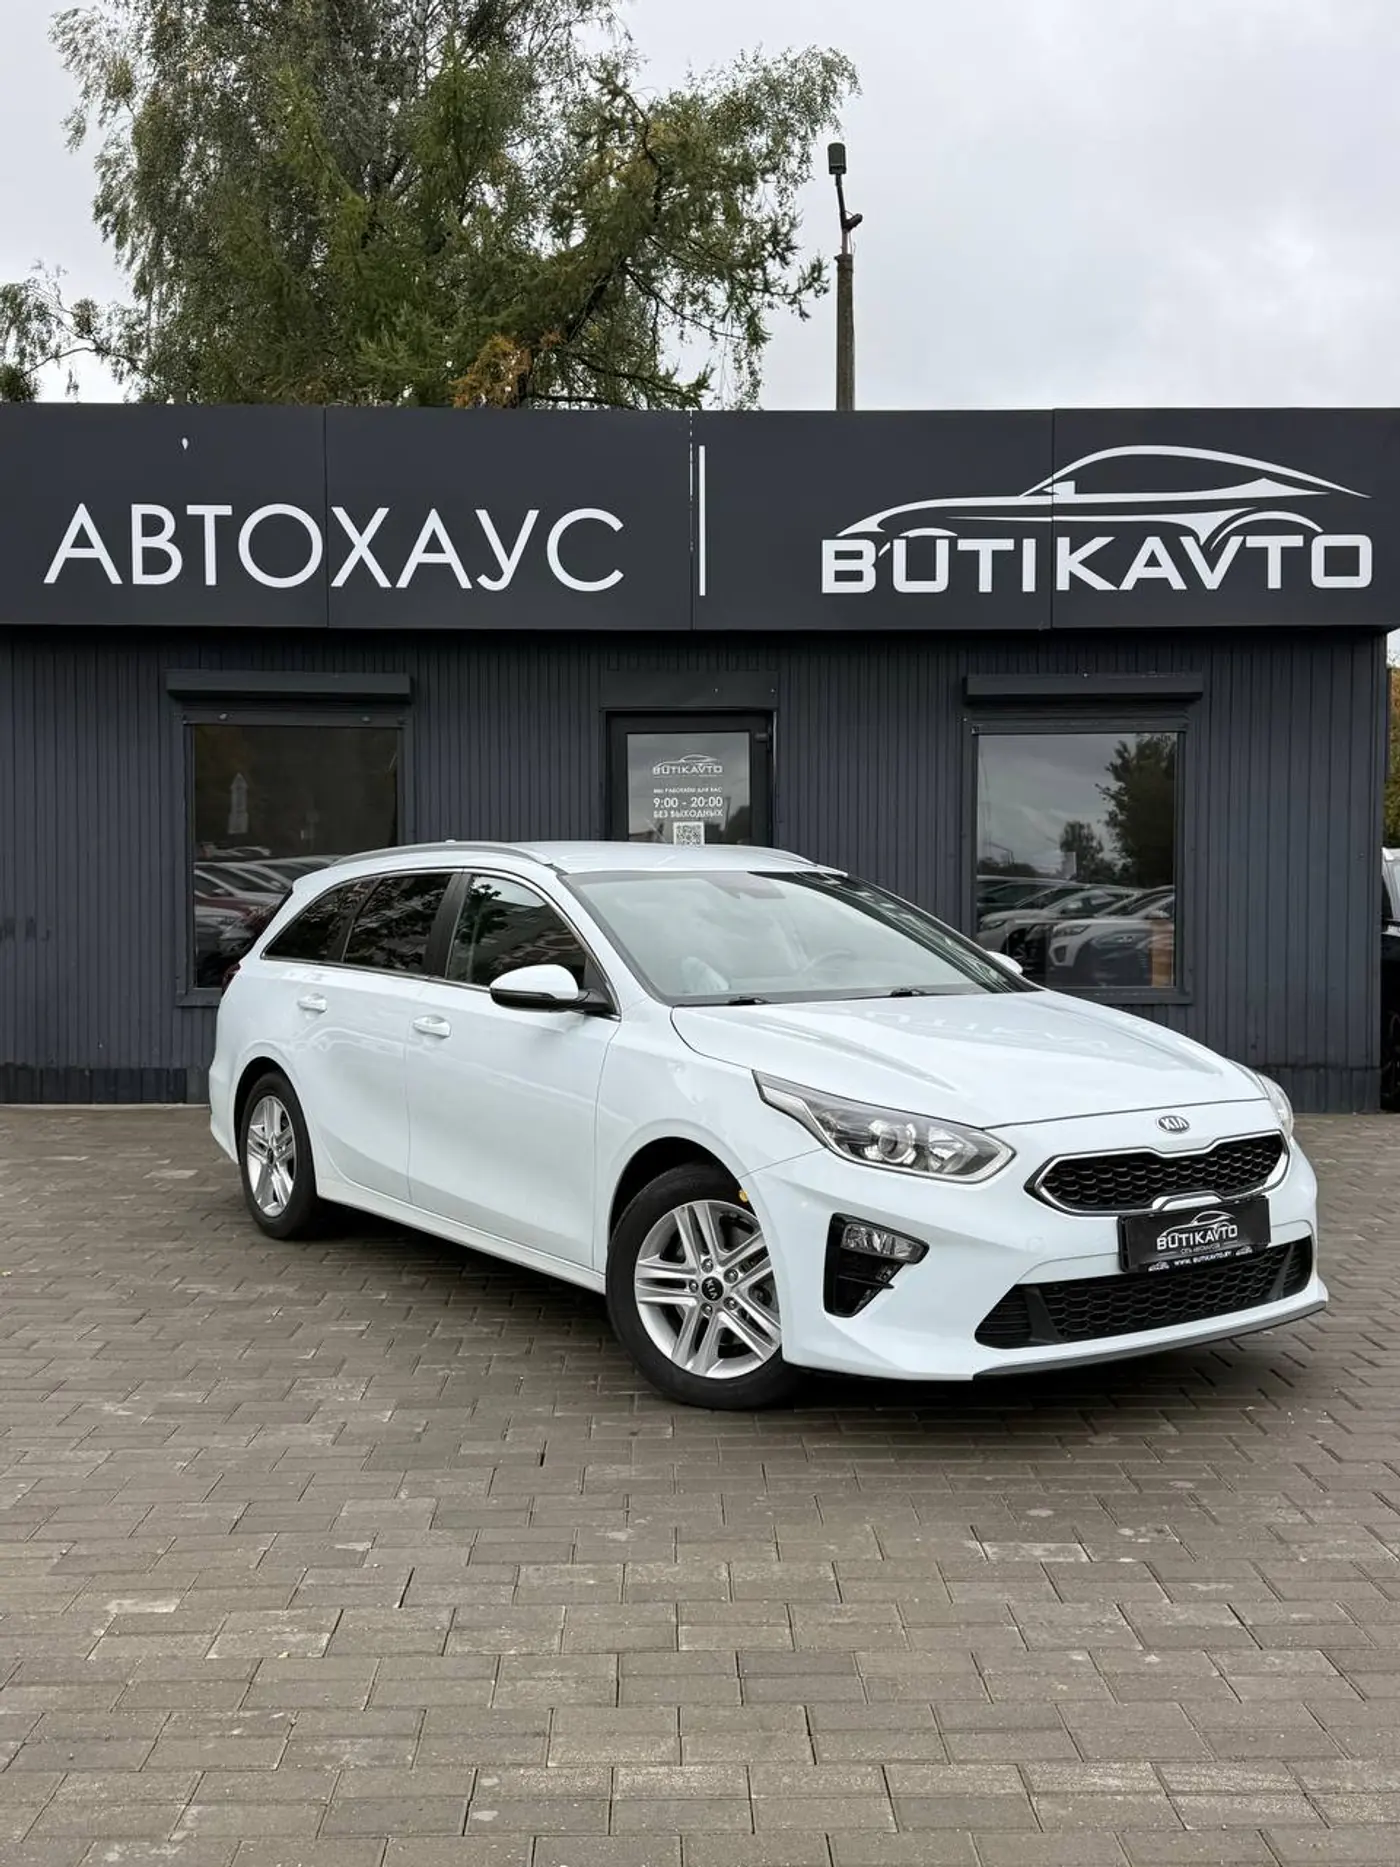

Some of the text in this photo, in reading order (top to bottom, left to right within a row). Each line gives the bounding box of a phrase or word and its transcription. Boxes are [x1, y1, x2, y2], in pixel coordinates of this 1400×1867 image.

[43, 502, 625, 592] АВТОХАУС
[821, 534, 1373, 595] BUTIKAVTO
[653, 765, 723, 775] BUTIKAVTO
[653, 797, 678, 808] 9:00
[691, 796, 723, 807] 20:00
[653, 810, 668, 818] БЕЗ
[1161, 1117, 1188, 1130] KIA
[1157, 1224, 1238, 1250] BUTIKAVTO
